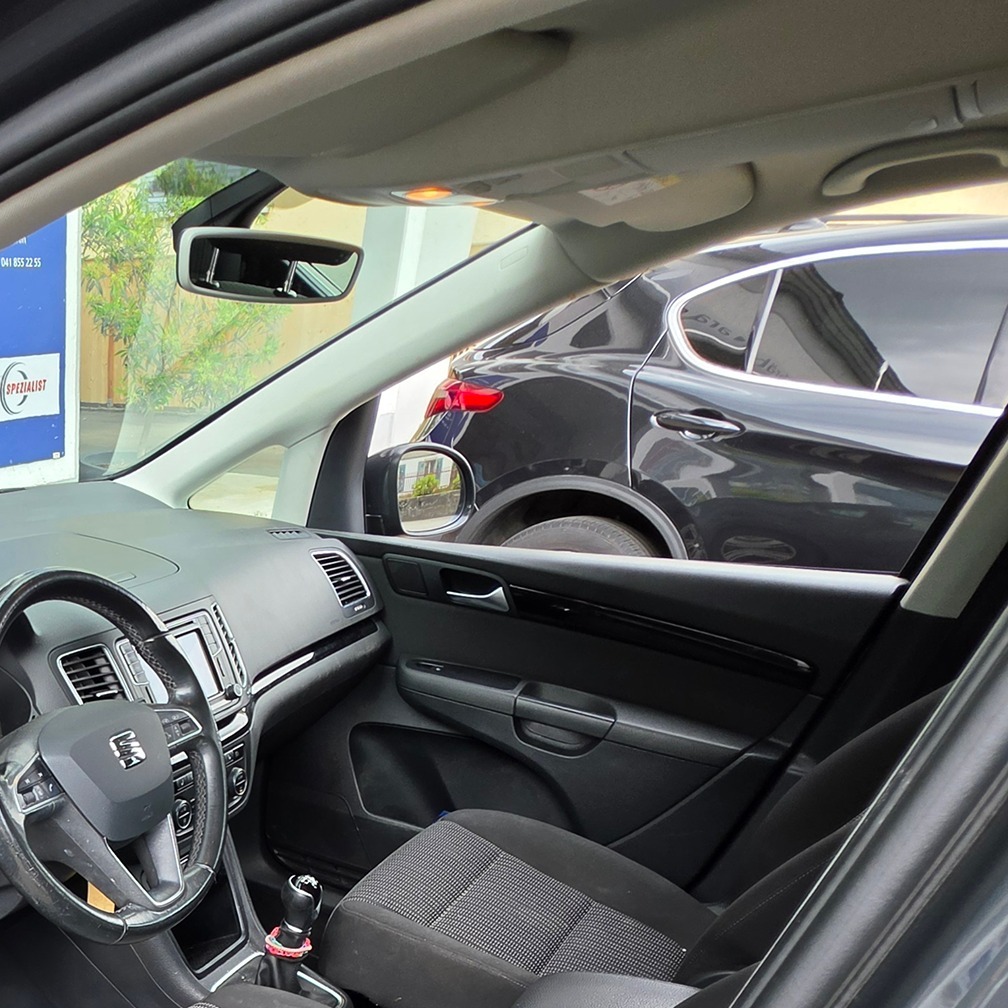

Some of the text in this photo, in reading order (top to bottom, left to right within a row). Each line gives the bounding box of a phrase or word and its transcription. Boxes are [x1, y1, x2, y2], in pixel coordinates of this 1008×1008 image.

[0, 257, 12, 267] 041
[13, 257, 25, 267] 855
[25, 257, 33, 267] 22
[33, 257, 42, 267] 55
[6, 379, 48, 396] SPEZIALIST
